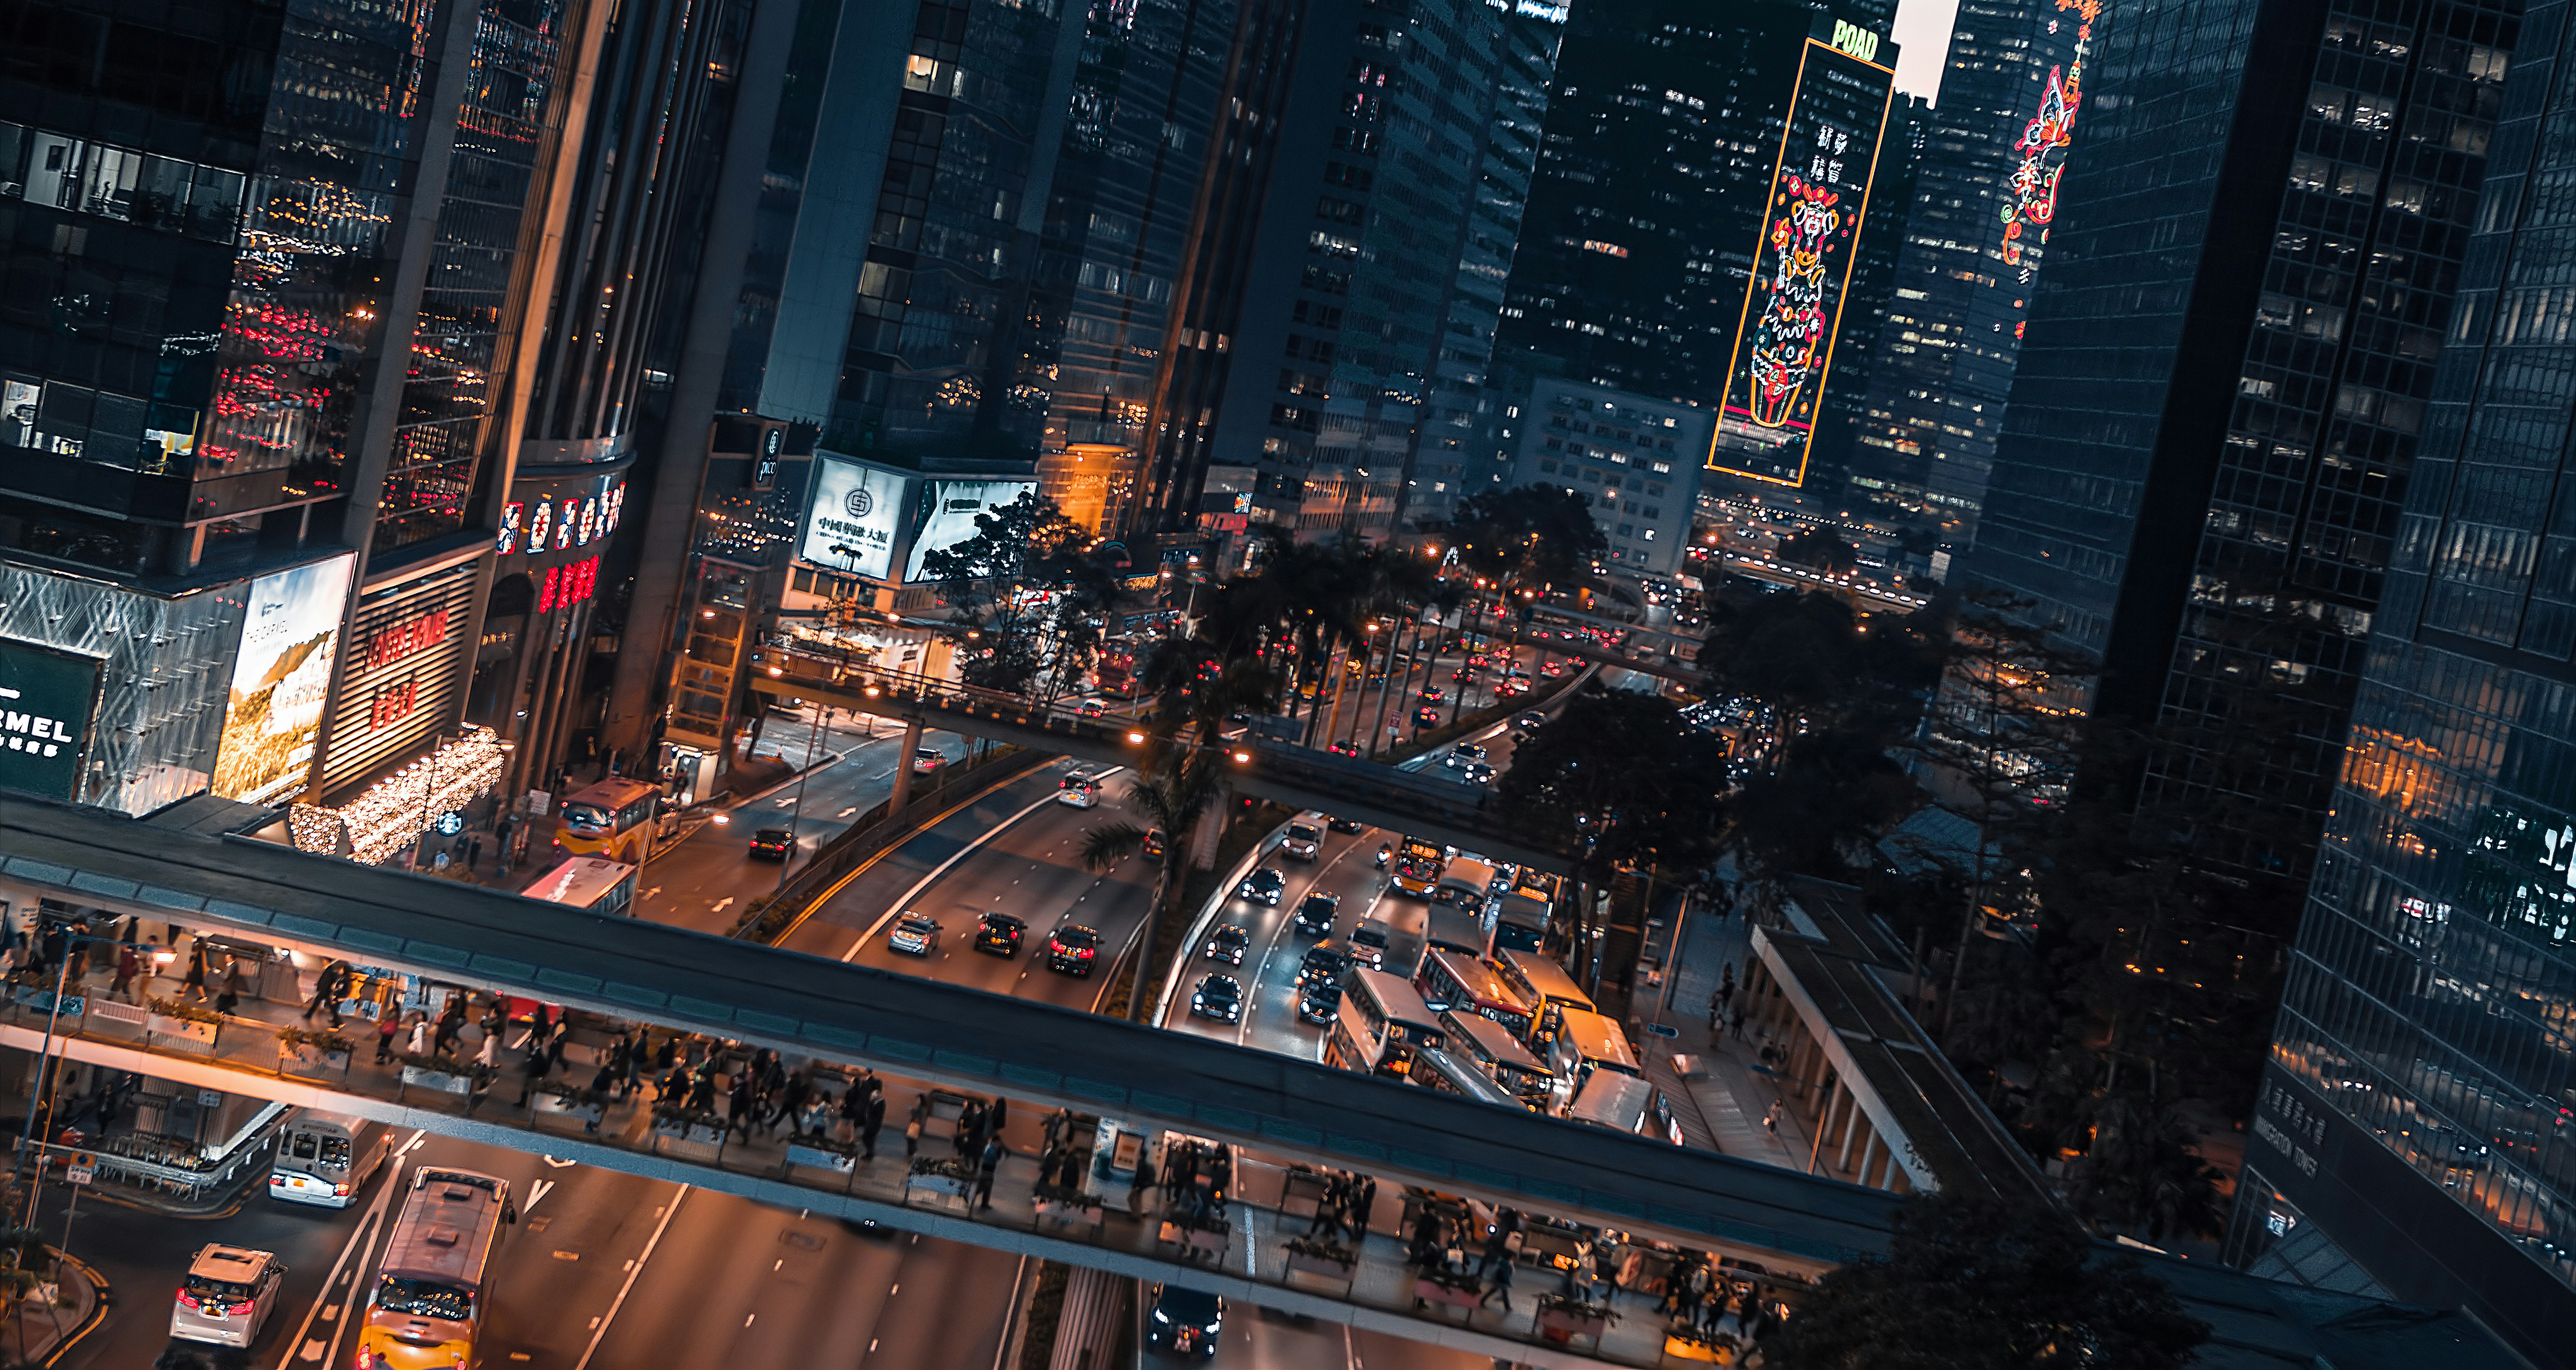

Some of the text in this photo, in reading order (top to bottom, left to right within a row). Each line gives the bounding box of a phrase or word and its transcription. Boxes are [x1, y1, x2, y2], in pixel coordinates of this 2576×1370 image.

[1831, 19, 1878, 62] POAD
[759, 457, 777, 481] pico
[261, 620, 288, 640] CARMEL
[0, 709, 73, 743] MEL
